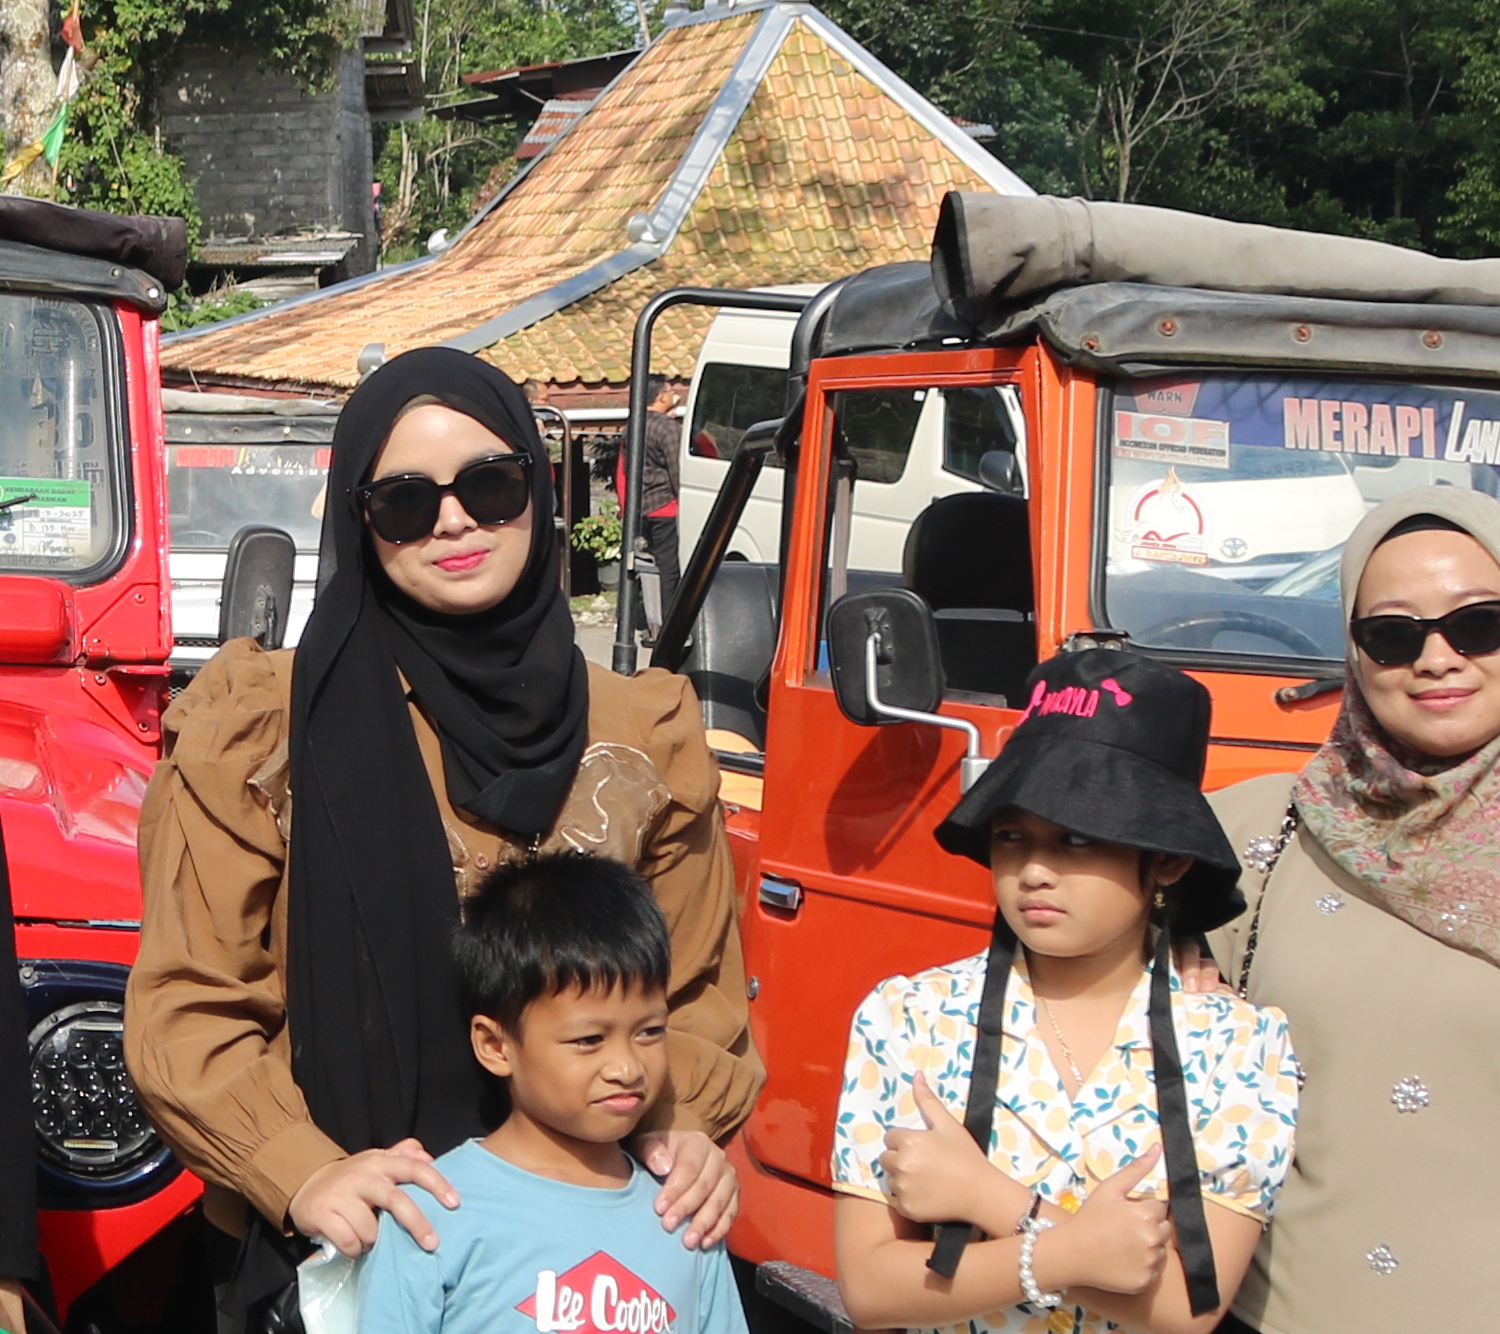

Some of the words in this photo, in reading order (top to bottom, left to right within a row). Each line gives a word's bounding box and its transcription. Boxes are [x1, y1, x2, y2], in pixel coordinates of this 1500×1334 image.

[1117, 413, 1226, 446] IOF
[1283, 397, 1437, 459] MERAPI
[536, 1269, 587, 1333] Lee
